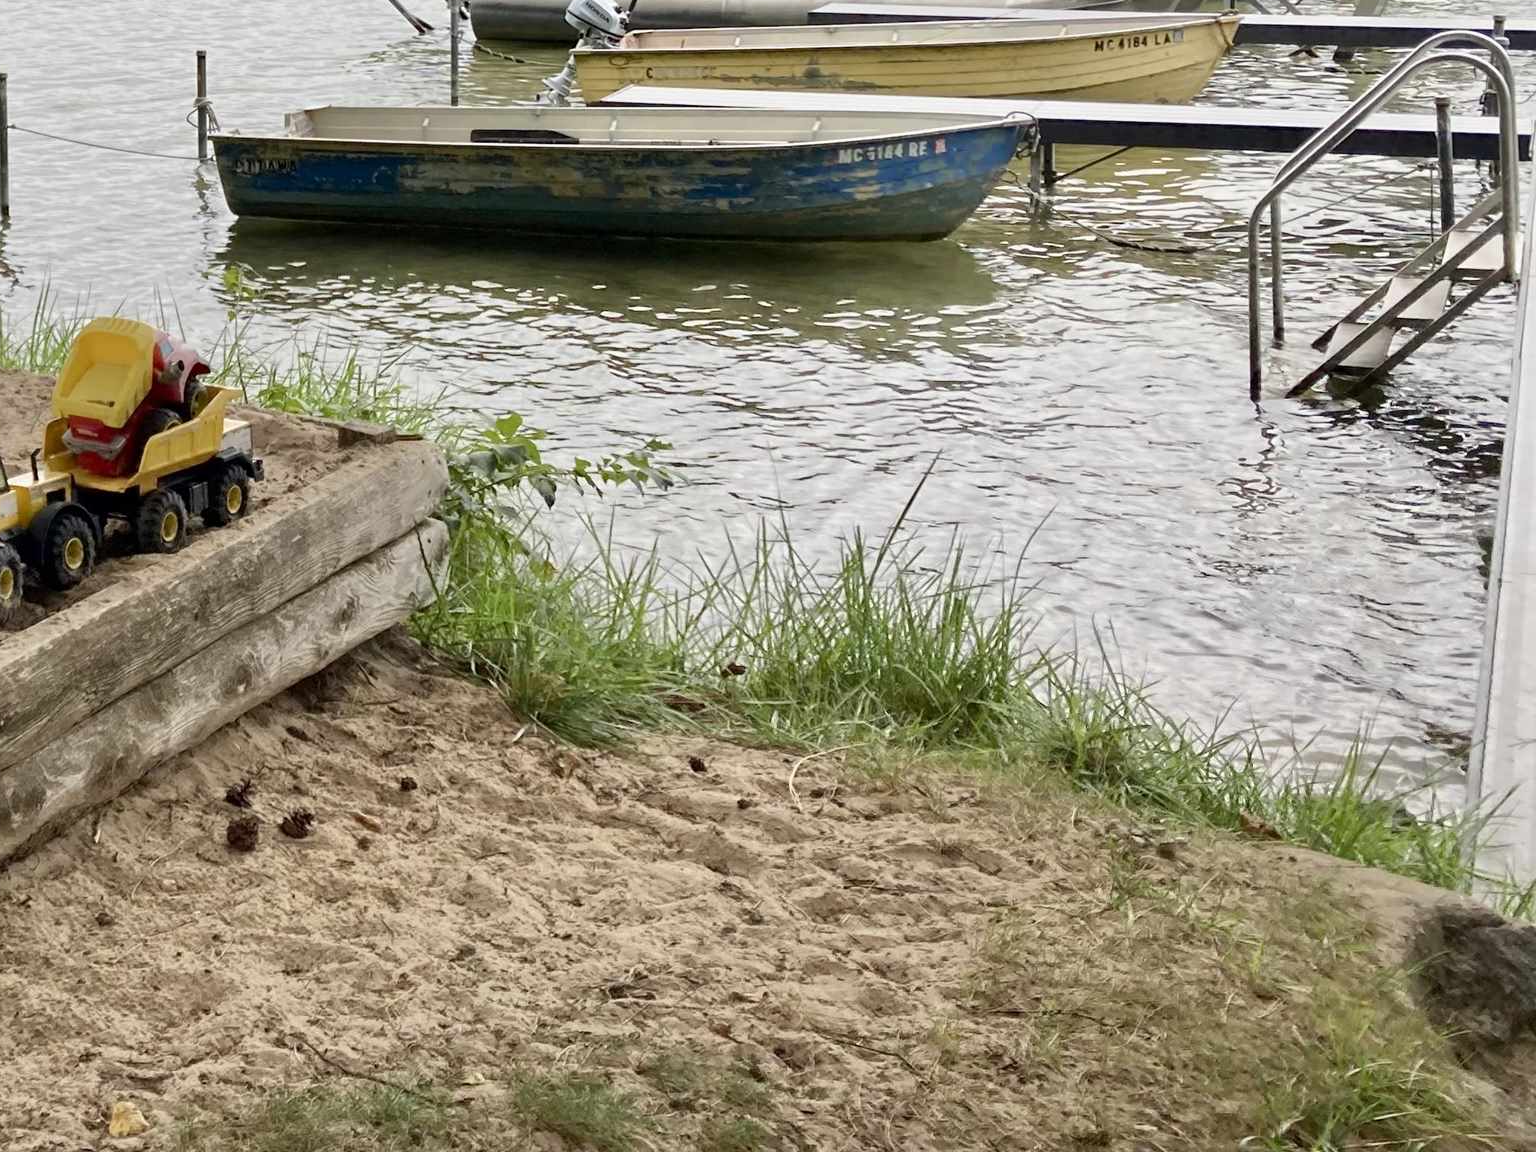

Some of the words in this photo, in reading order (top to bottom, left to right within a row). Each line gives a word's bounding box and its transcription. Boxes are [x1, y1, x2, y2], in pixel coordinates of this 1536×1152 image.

[1093, 38, 1116, 53] MC
[1117, 34, 1148, 50] 4184
[1154, 34, 1172, 46] LA
[837, 147, 864, 164] MC
